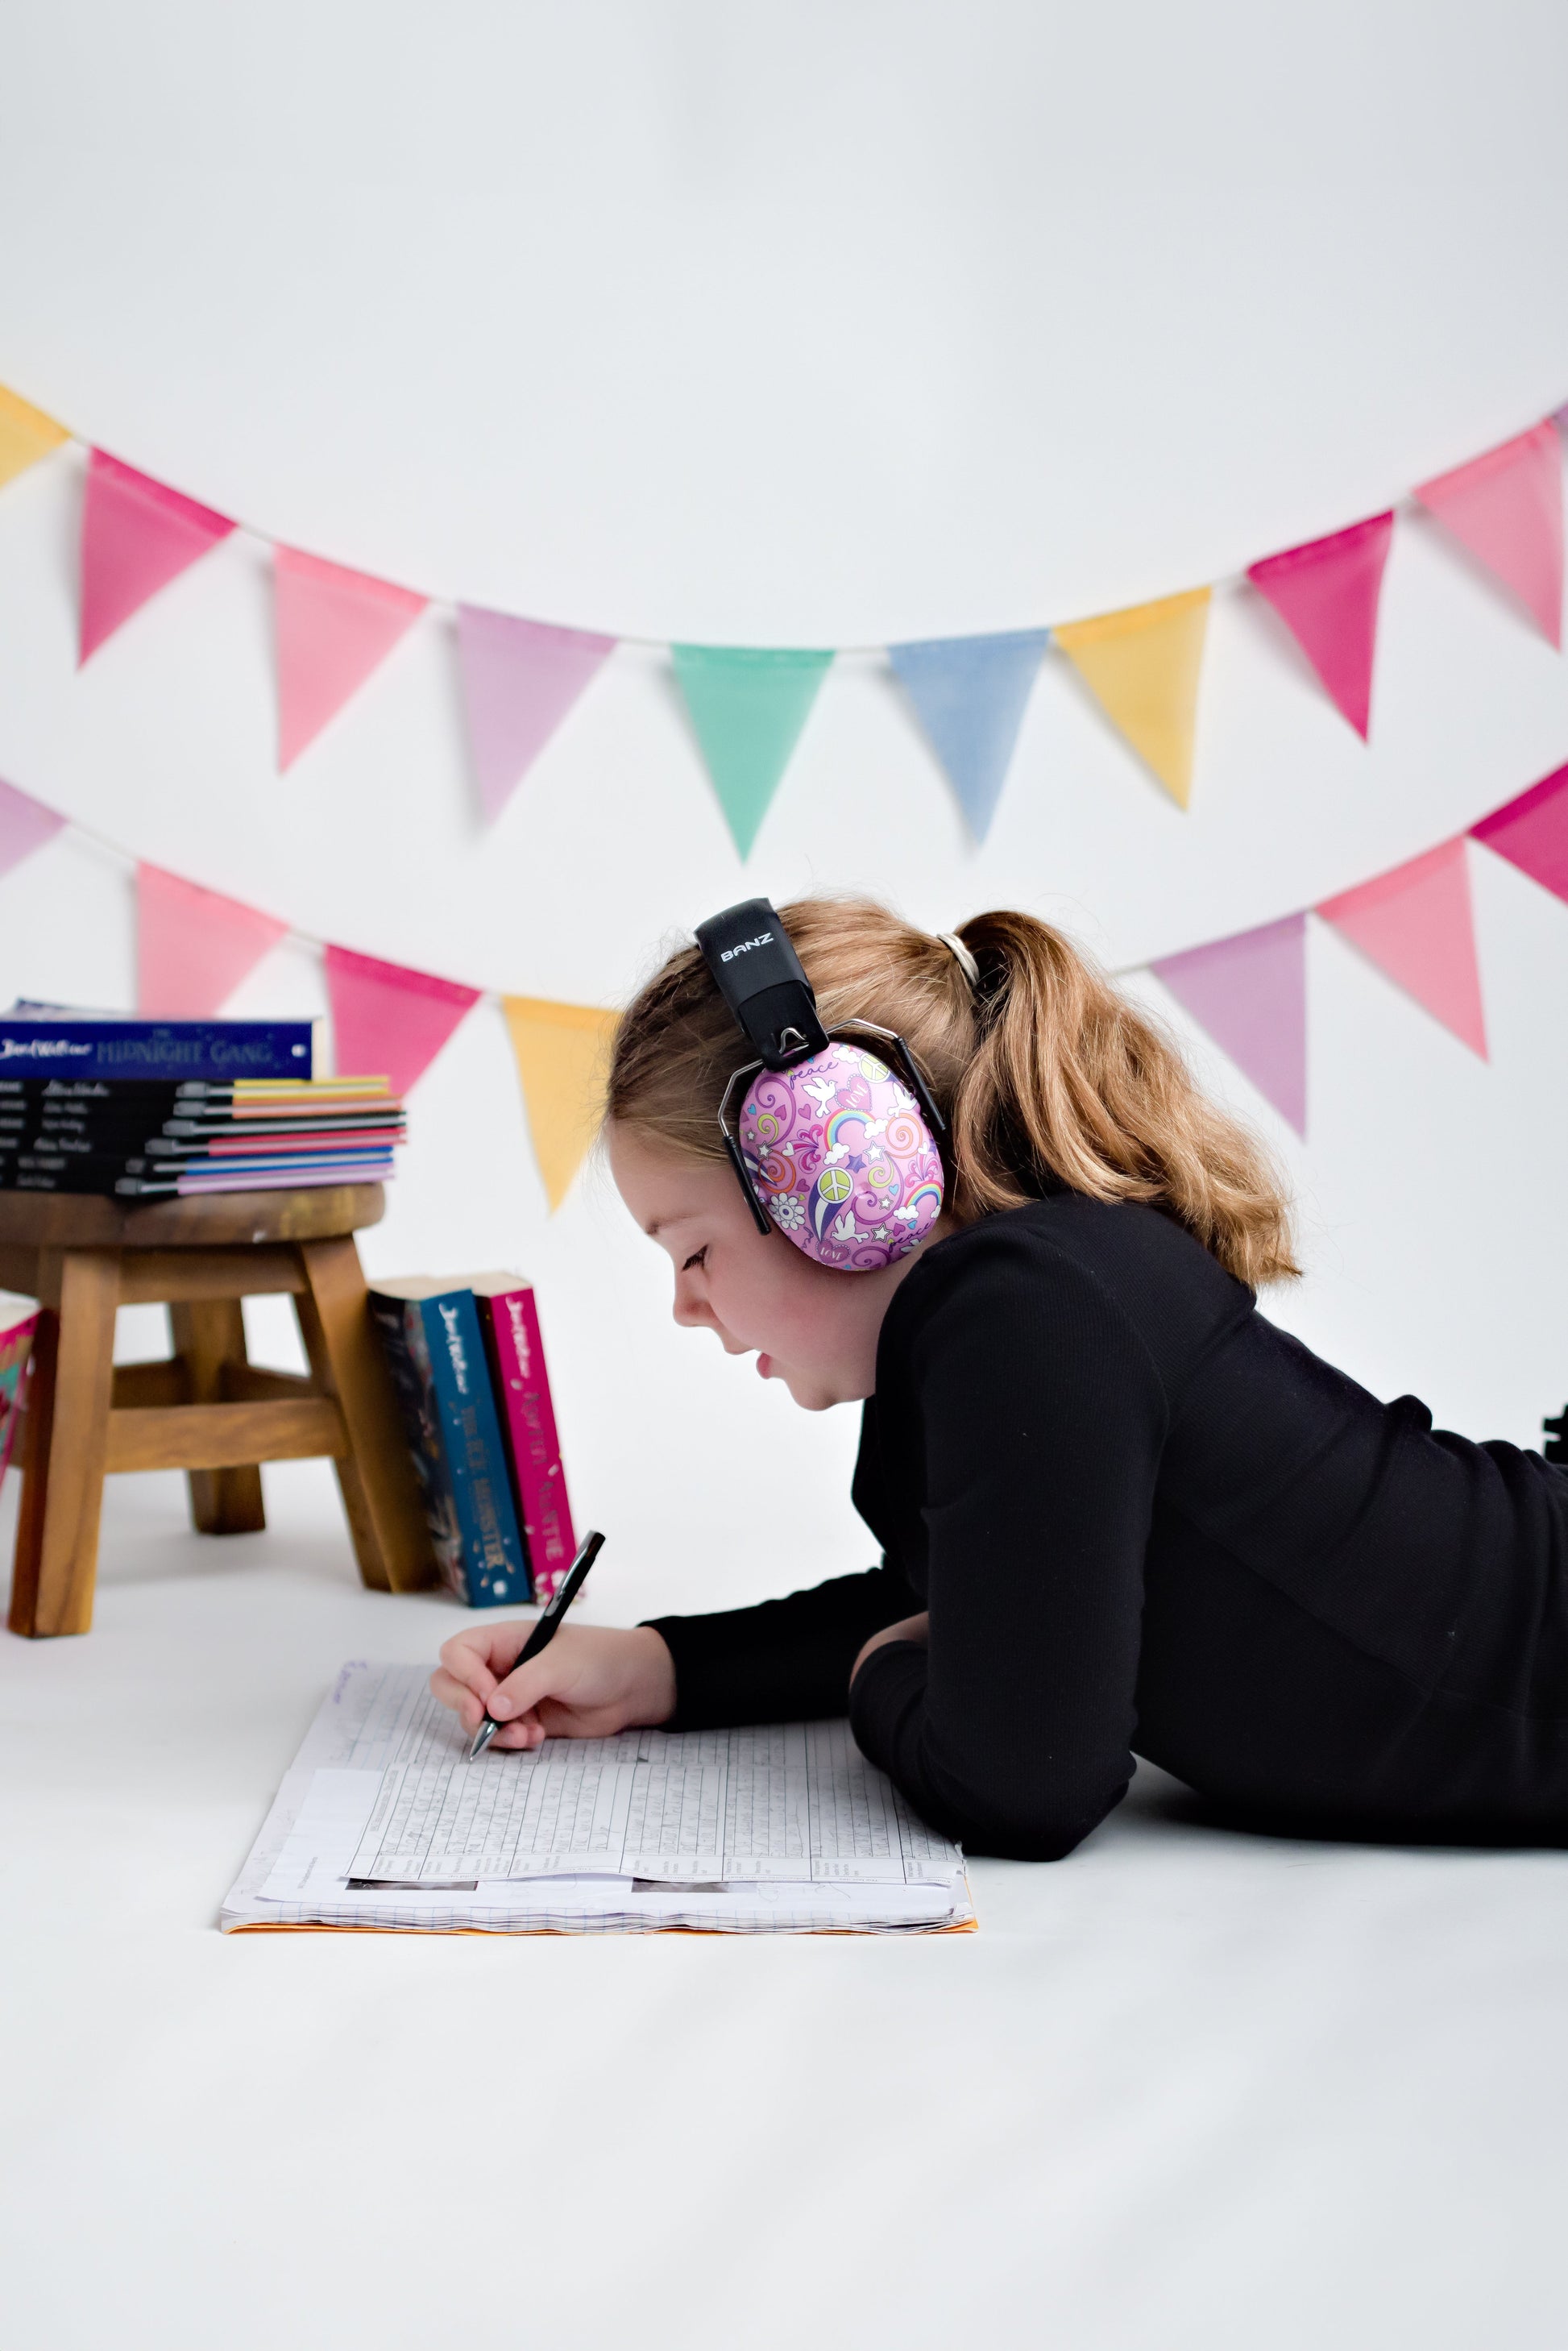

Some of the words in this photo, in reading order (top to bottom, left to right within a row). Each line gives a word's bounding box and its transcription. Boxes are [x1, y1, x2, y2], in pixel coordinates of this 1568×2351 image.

[720, 933, 774, 962] BANZ
[790, 1061, 839, 1090] peace
[889, 1221, 933, 1253] peace
[820, 1246, 843, 1261] LOVE
